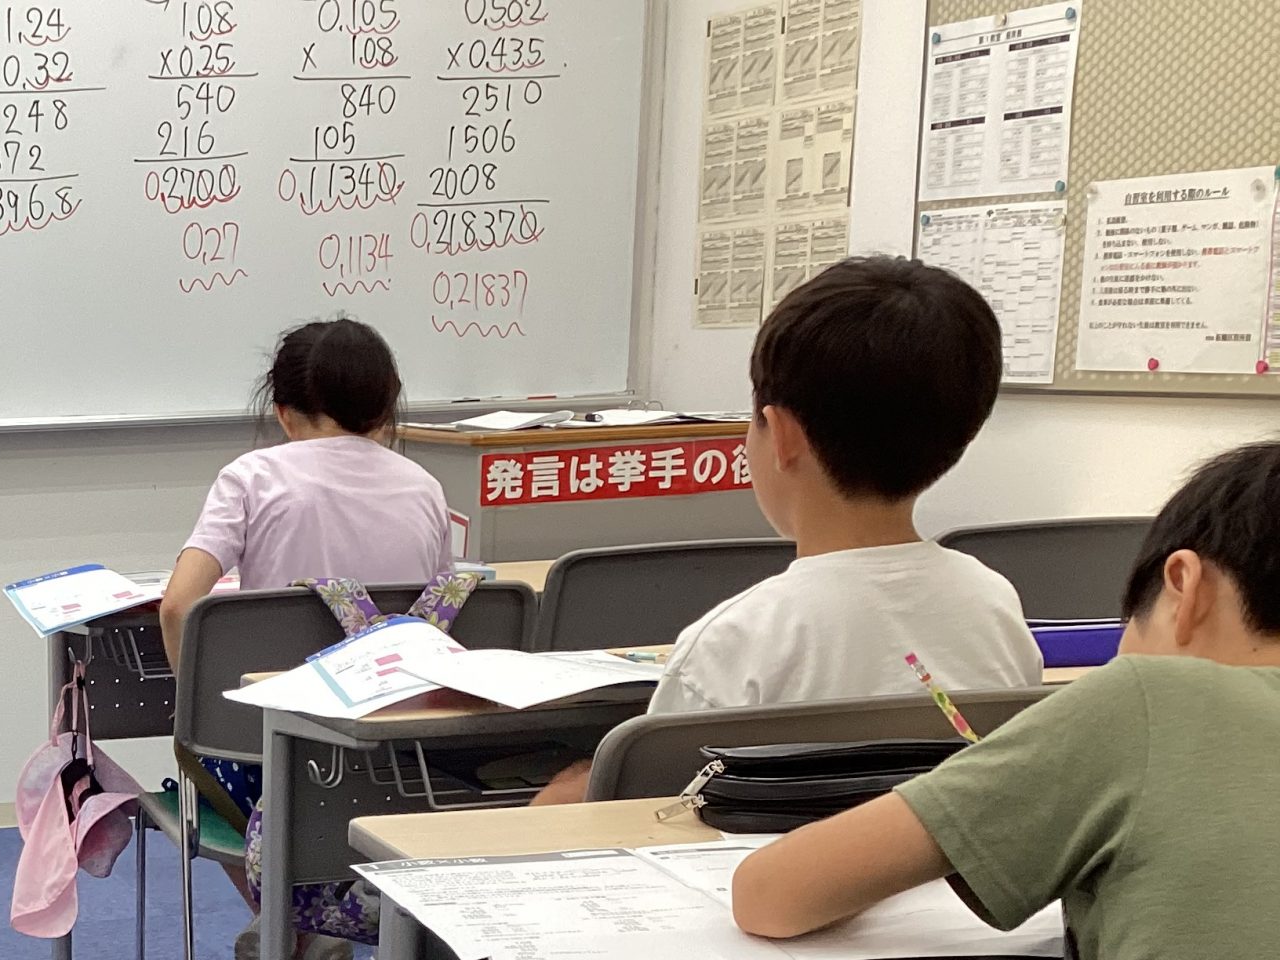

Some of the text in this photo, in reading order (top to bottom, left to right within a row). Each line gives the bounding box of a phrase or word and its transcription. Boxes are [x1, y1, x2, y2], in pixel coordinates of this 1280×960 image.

[6, 7, 66, 43] 1.24
[177, 81, 236, 120] 540
[340, 83, 397, 119] 840
[462, 79, 543, 117] 2510
[3, 99, 69, 136] 248
[157, 120, 215, 158] 216
[314, 121, 356, 161] 105
[448, 118, 516, 162] 1506
[429, 162, 498, 200] 2008
